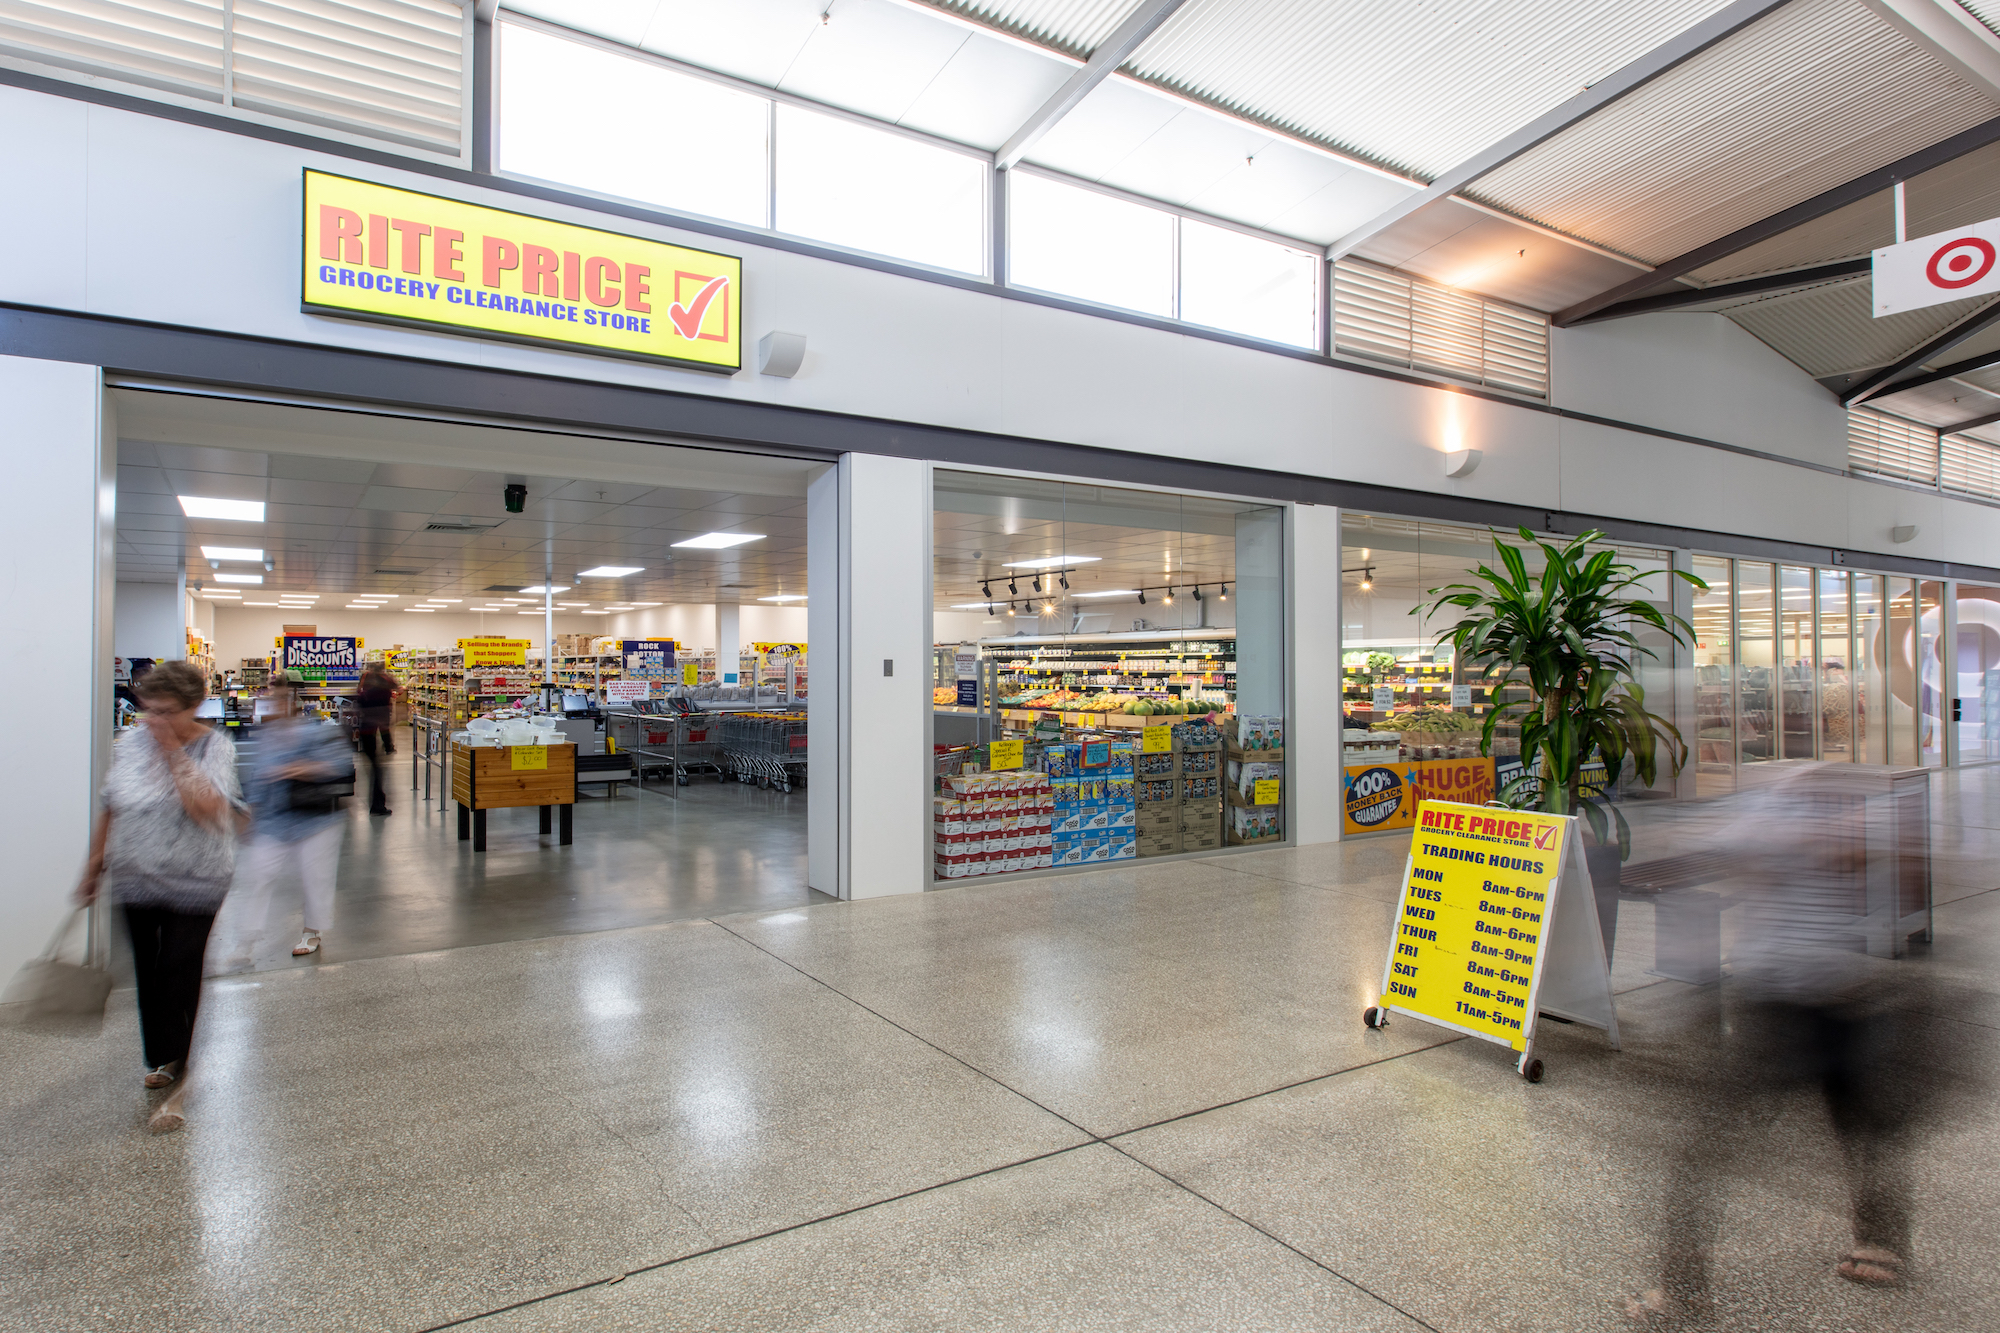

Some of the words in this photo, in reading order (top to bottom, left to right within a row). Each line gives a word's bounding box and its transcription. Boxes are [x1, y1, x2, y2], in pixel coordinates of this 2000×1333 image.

[319, 203, 465, 283] RITE
[482, 235, 652, 314] PRICE
[319, 265, 440, 301] GROCERY
[446, 286, 578, 322] CLEARANCE
[584, 308, 651, 334] STORE
[288, 645, 354, 666] DISCOUNTS
[292, 640, 349, 653] HUGE
[458, 641, 463, 649] 2
[638, 642, 660, 650] ROCK
[1354, 771, 1392, 799] 100%
[1417, 764, 1486, 791] HUGE
[1346, 796, 1377, 811] MONEY
[1379, 786, 1403, 800] BACK
[1354, 798, 1398, 824] GUARANTEE
[1420, 826, 1455, 836] GROCERY
[1456, 831, 1502, 844] CLEARANCE
[1503, 838, 1530, 848] STORE
[1421, 809, 1466, 831] RITE
[1468, 815, 1533, 841] PRICE
[1422, 843, 1485, 864] TRADING
[1488, 854, 1544, 874] HOURS
[1413, 867, 1444, 883] MON
[1482, 880, 1545, 902] 8AM-6PM
[1410, 886, 1442, 902] TUES
[1478, 900, 1541, 923] 8AM-6PM
[1406, 905, 1436, 921] WED
[1474, 920, 1537, 944] 8AM-6PM
[1402, 923, 1437, 942] THUR
[1471, 940, 1533, 966] 8AM-9PM
[1397, 943, 1419, 958] FRI
[1467, 960, 1529, 987] 8AM-6PM
[1393, 962, 1419, 978] SAT
[1463, 981, 1525, 1009] 8AM-5PM
[1389, 981, 1417, 999] SUN
[1456, 1000, 1521, 1030] 11AM-5PM
